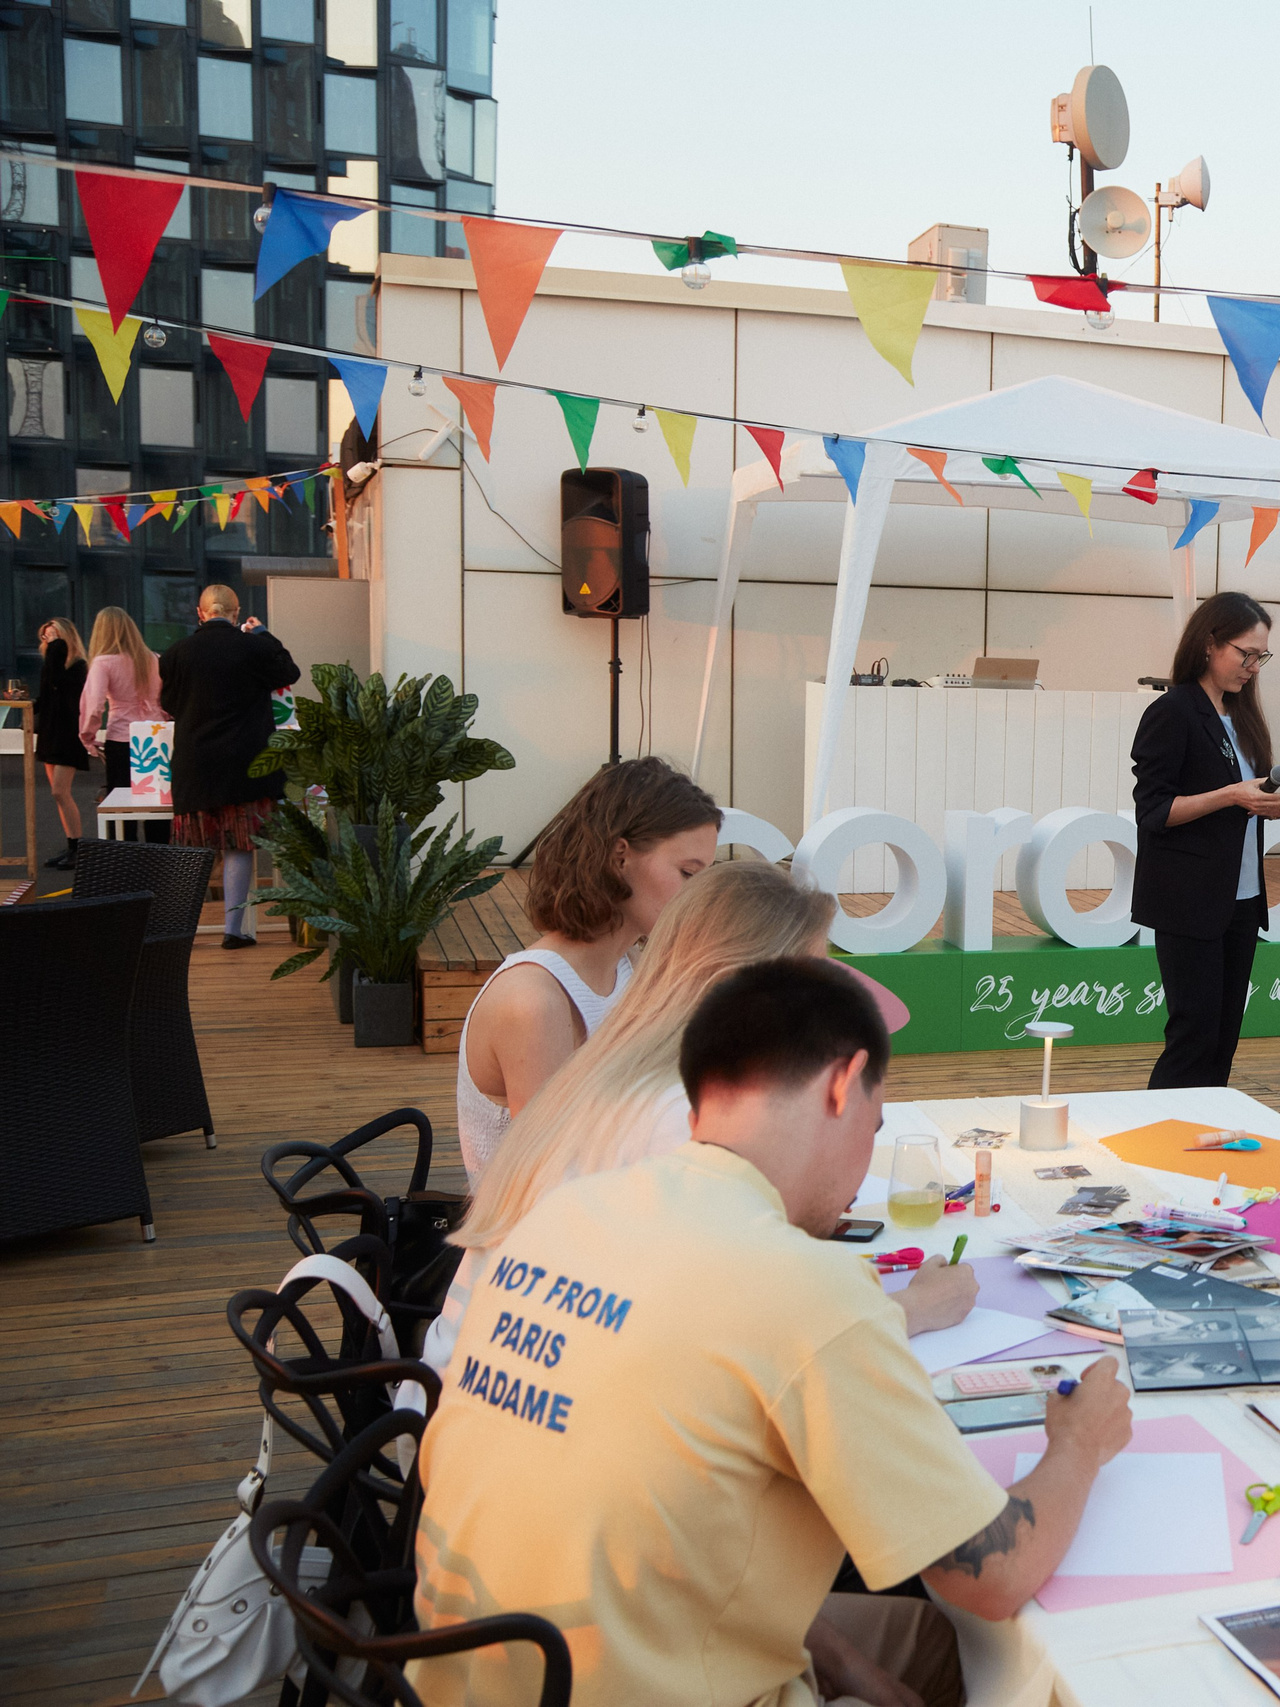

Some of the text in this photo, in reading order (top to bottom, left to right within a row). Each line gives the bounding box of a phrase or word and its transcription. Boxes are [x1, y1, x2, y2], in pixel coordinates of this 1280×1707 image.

[970, 975, 1014, 1013] 25
[1004, 980, 1131, 1040] years
[489, 1256, 633, 1334] NOT FROM
[490, 1312, 567, 1369] PARIS
[457, 1355, 574, 1433] MADAME
